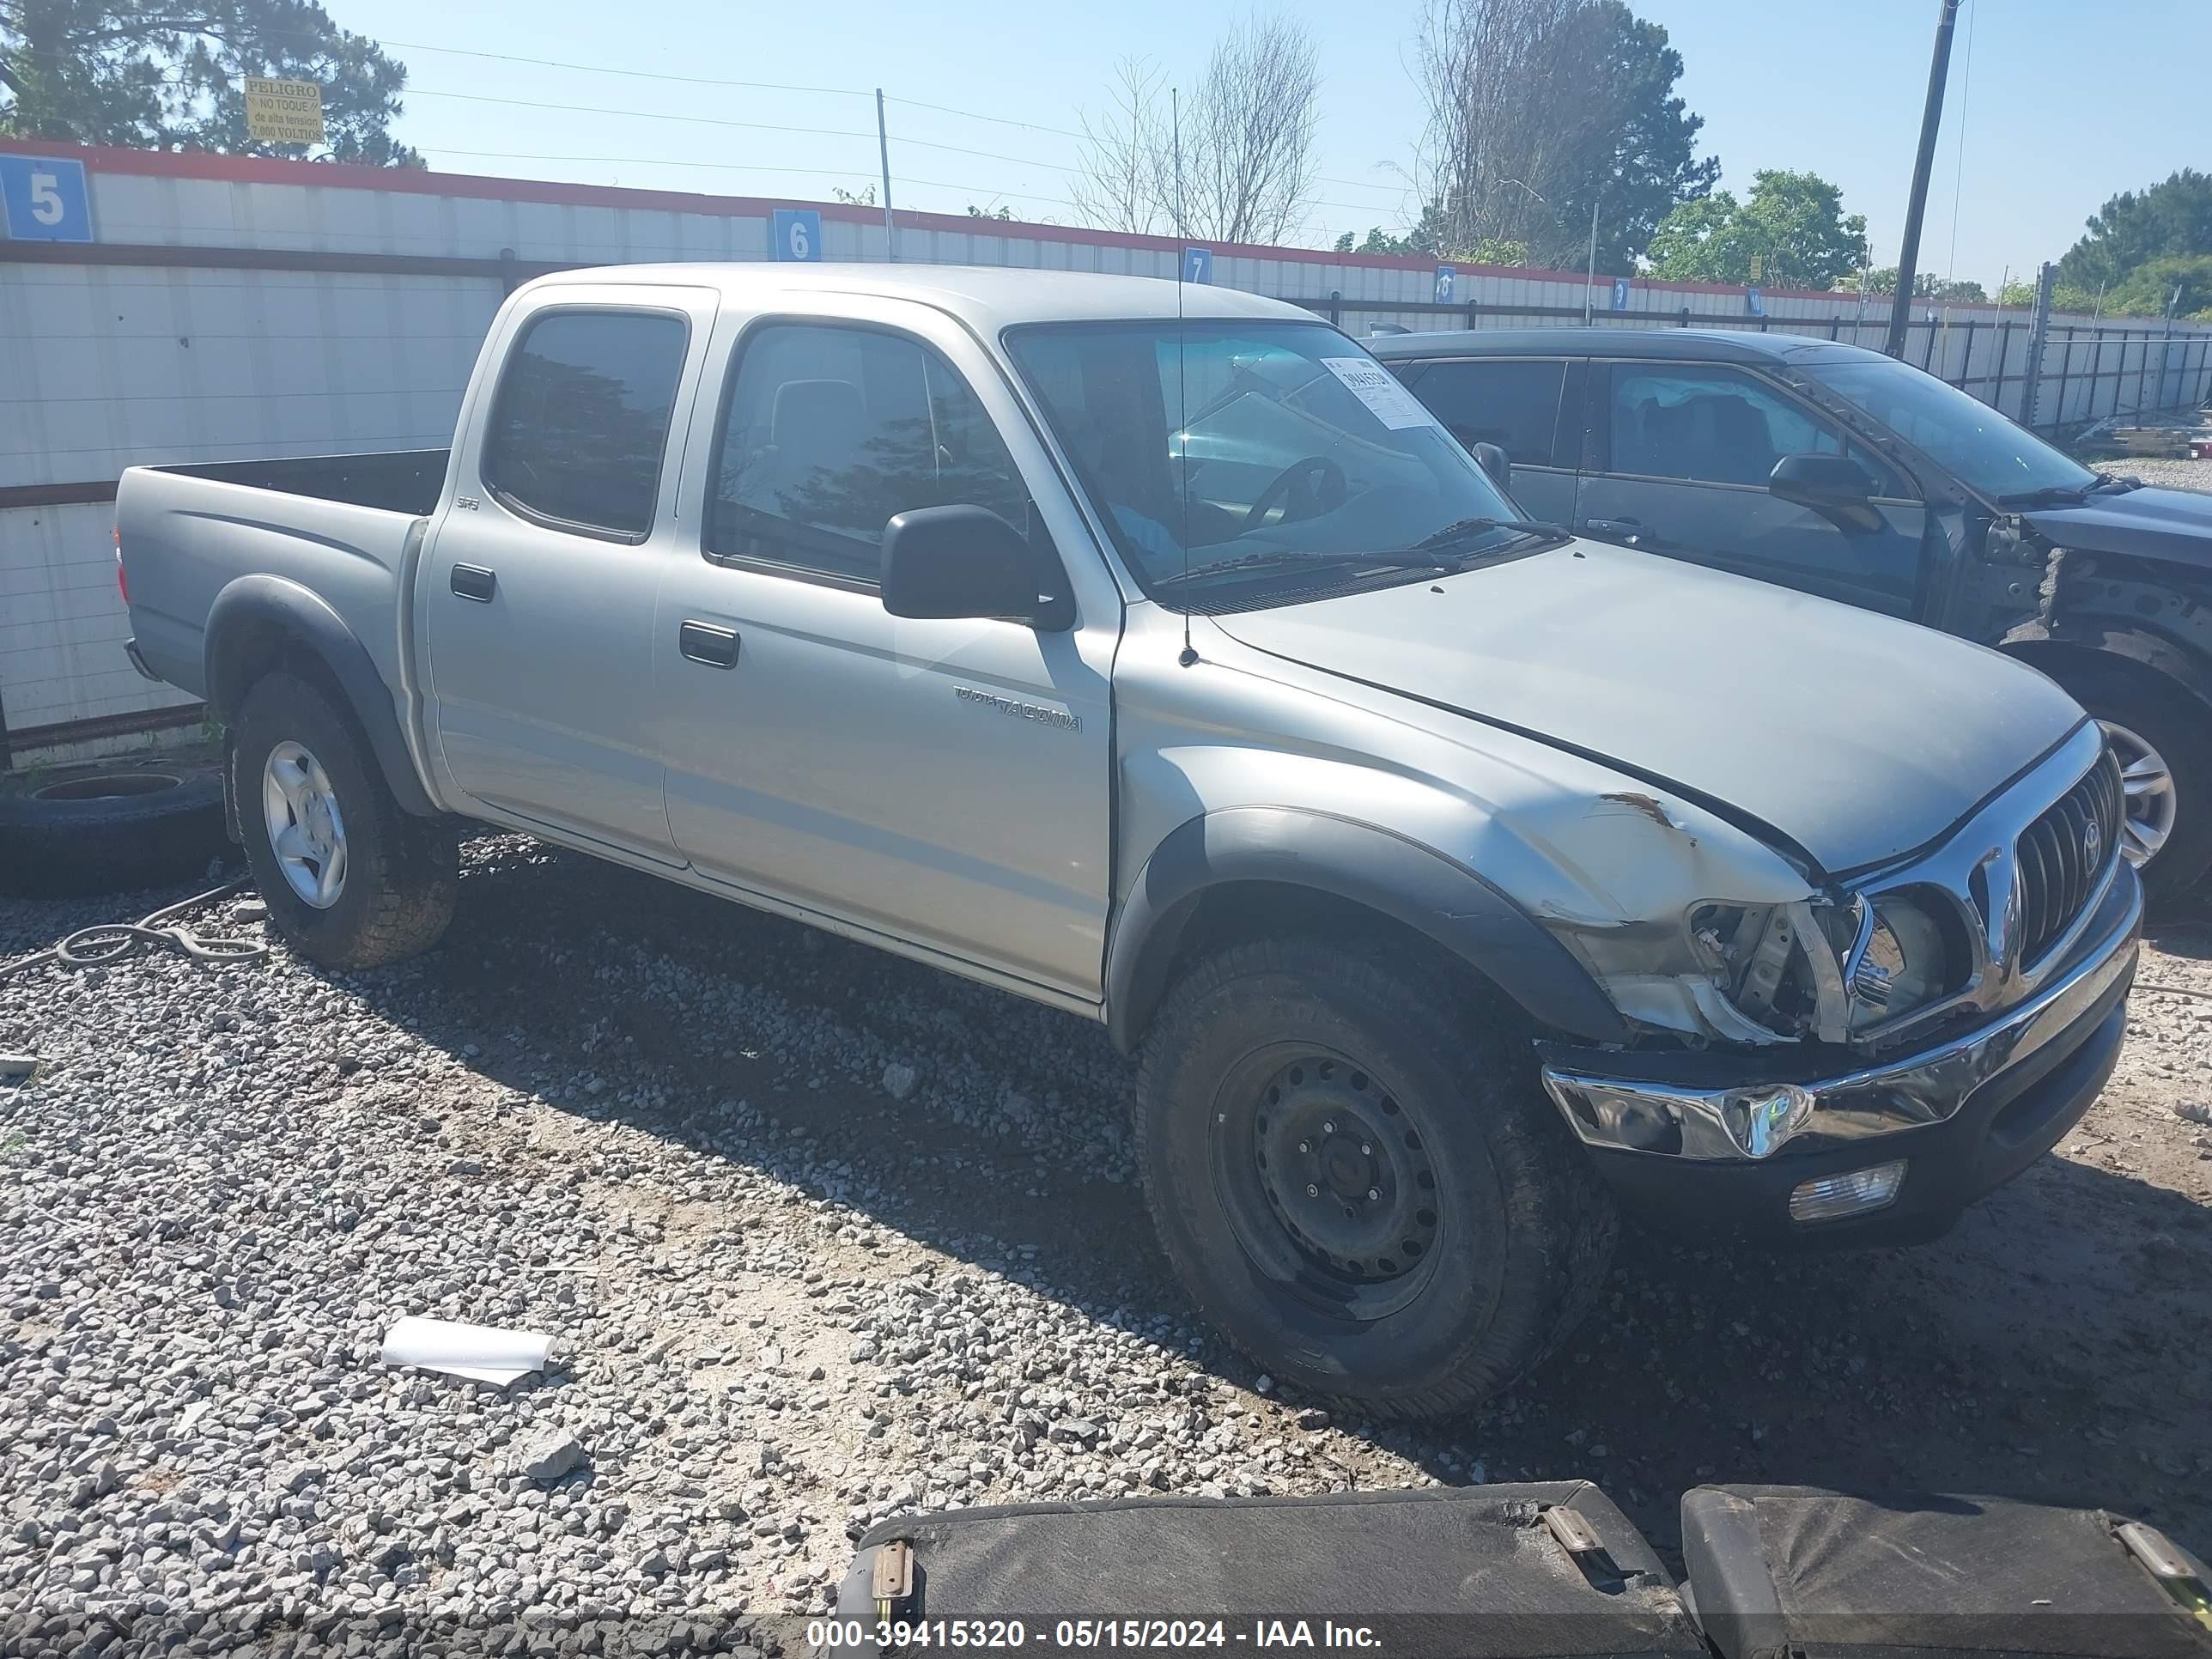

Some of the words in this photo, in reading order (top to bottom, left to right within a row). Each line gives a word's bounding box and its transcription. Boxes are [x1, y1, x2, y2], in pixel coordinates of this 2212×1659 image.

[248, 81, 317, 98] PELIGRO
[260, 98, 274, 110] NO
[276, 100, 308, 112] TOQUE
[255, 112, 265, 123] de
[268, 113, 283, 124] alta
[286, 115, 318, 126] tension
[277, 127, 322, 141] VOLTIOS
[31, 173, 64, 225] 5
[790, 222, 809, 258] 6
[1194, 258, 1203, 283] 7
[1614, 283, 1624, 304] 9
[997, 696, 1083, 735] TACOMA
